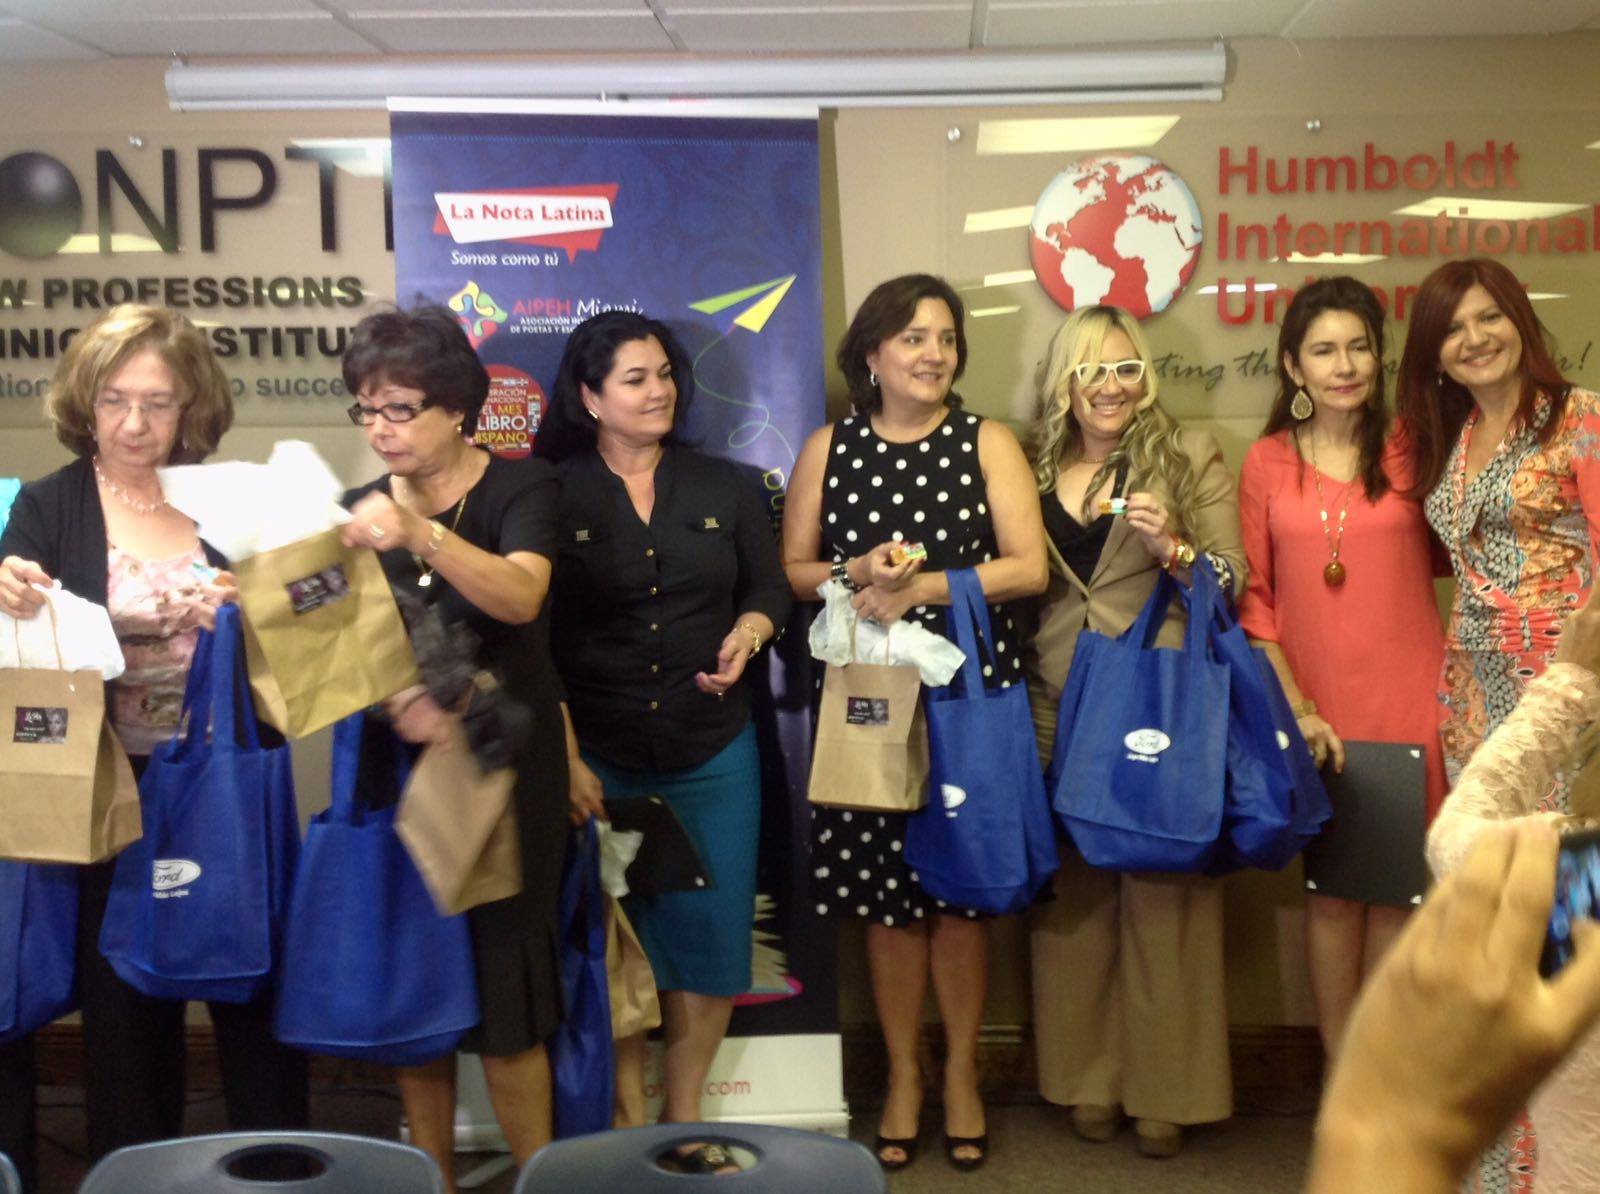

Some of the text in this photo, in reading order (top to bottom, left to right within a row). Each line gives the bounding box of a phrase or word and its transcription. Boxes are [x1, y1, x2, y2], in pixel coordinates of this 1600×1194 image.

[1218, 140, 1520, 195] Humboldt
[451, 204, 606, 222] La Nota Latina
[451, 251, 498, 266] Somos
[501, 256, 540, 266] como
[43, 277, 364, 308] PROFESSIONS
[512, 297, 572, 316] AIPEH
[523, 325, 552, 334] POETAS
[256, 376, 344, 397] succe
[478, 416, 527, 431] LIBRO
